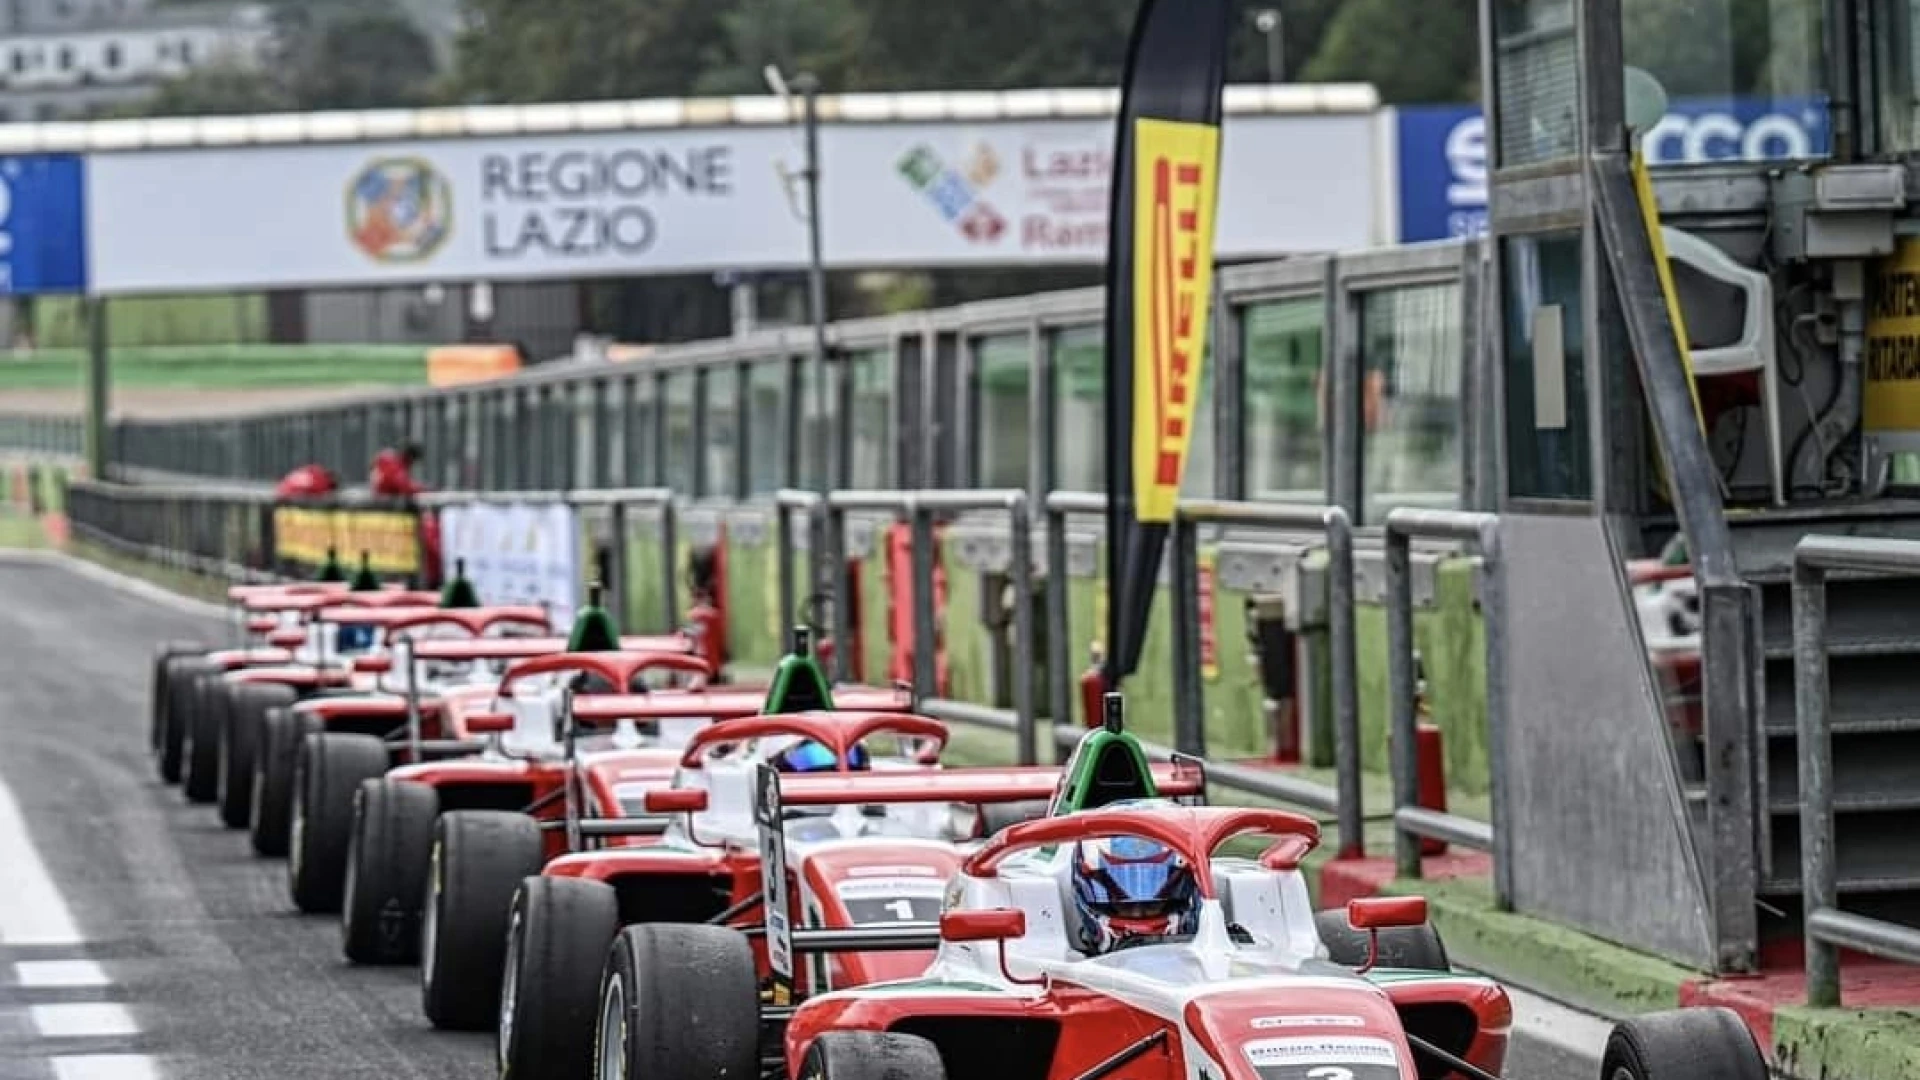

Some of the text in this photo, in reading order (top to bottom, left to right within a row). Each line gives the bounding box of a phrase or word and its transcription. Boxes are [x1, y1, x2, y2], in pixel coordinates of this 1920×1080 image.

[483, 146, 732, 201] REGIONE
[484, 204, 655, 258] LAZIO
[1151, 157, 1200, 484] PIRELLI
[884, 899, 914, 919] 1
